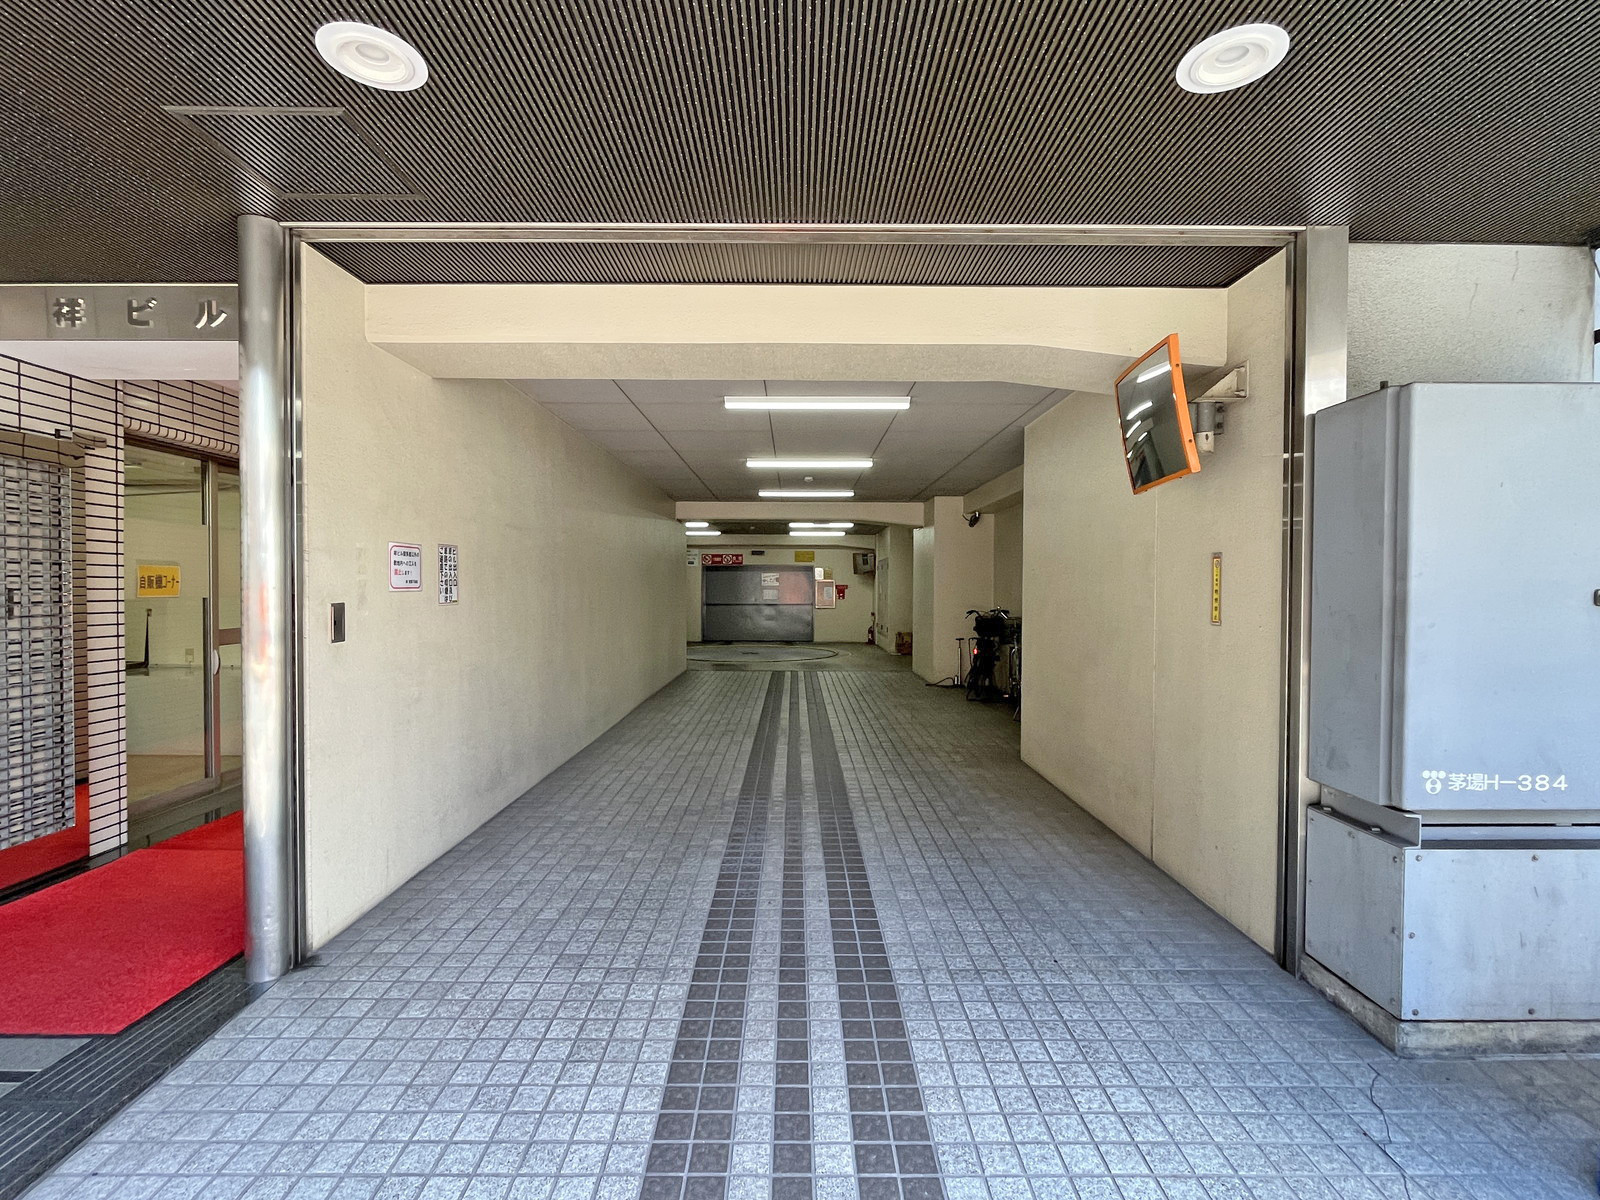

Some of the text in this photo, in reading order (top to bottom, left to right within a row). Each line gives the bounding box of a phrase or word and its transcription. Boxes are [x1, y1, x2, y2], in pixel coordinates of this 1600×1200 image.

[139, 574, 180, 589] 自販機コーナー
